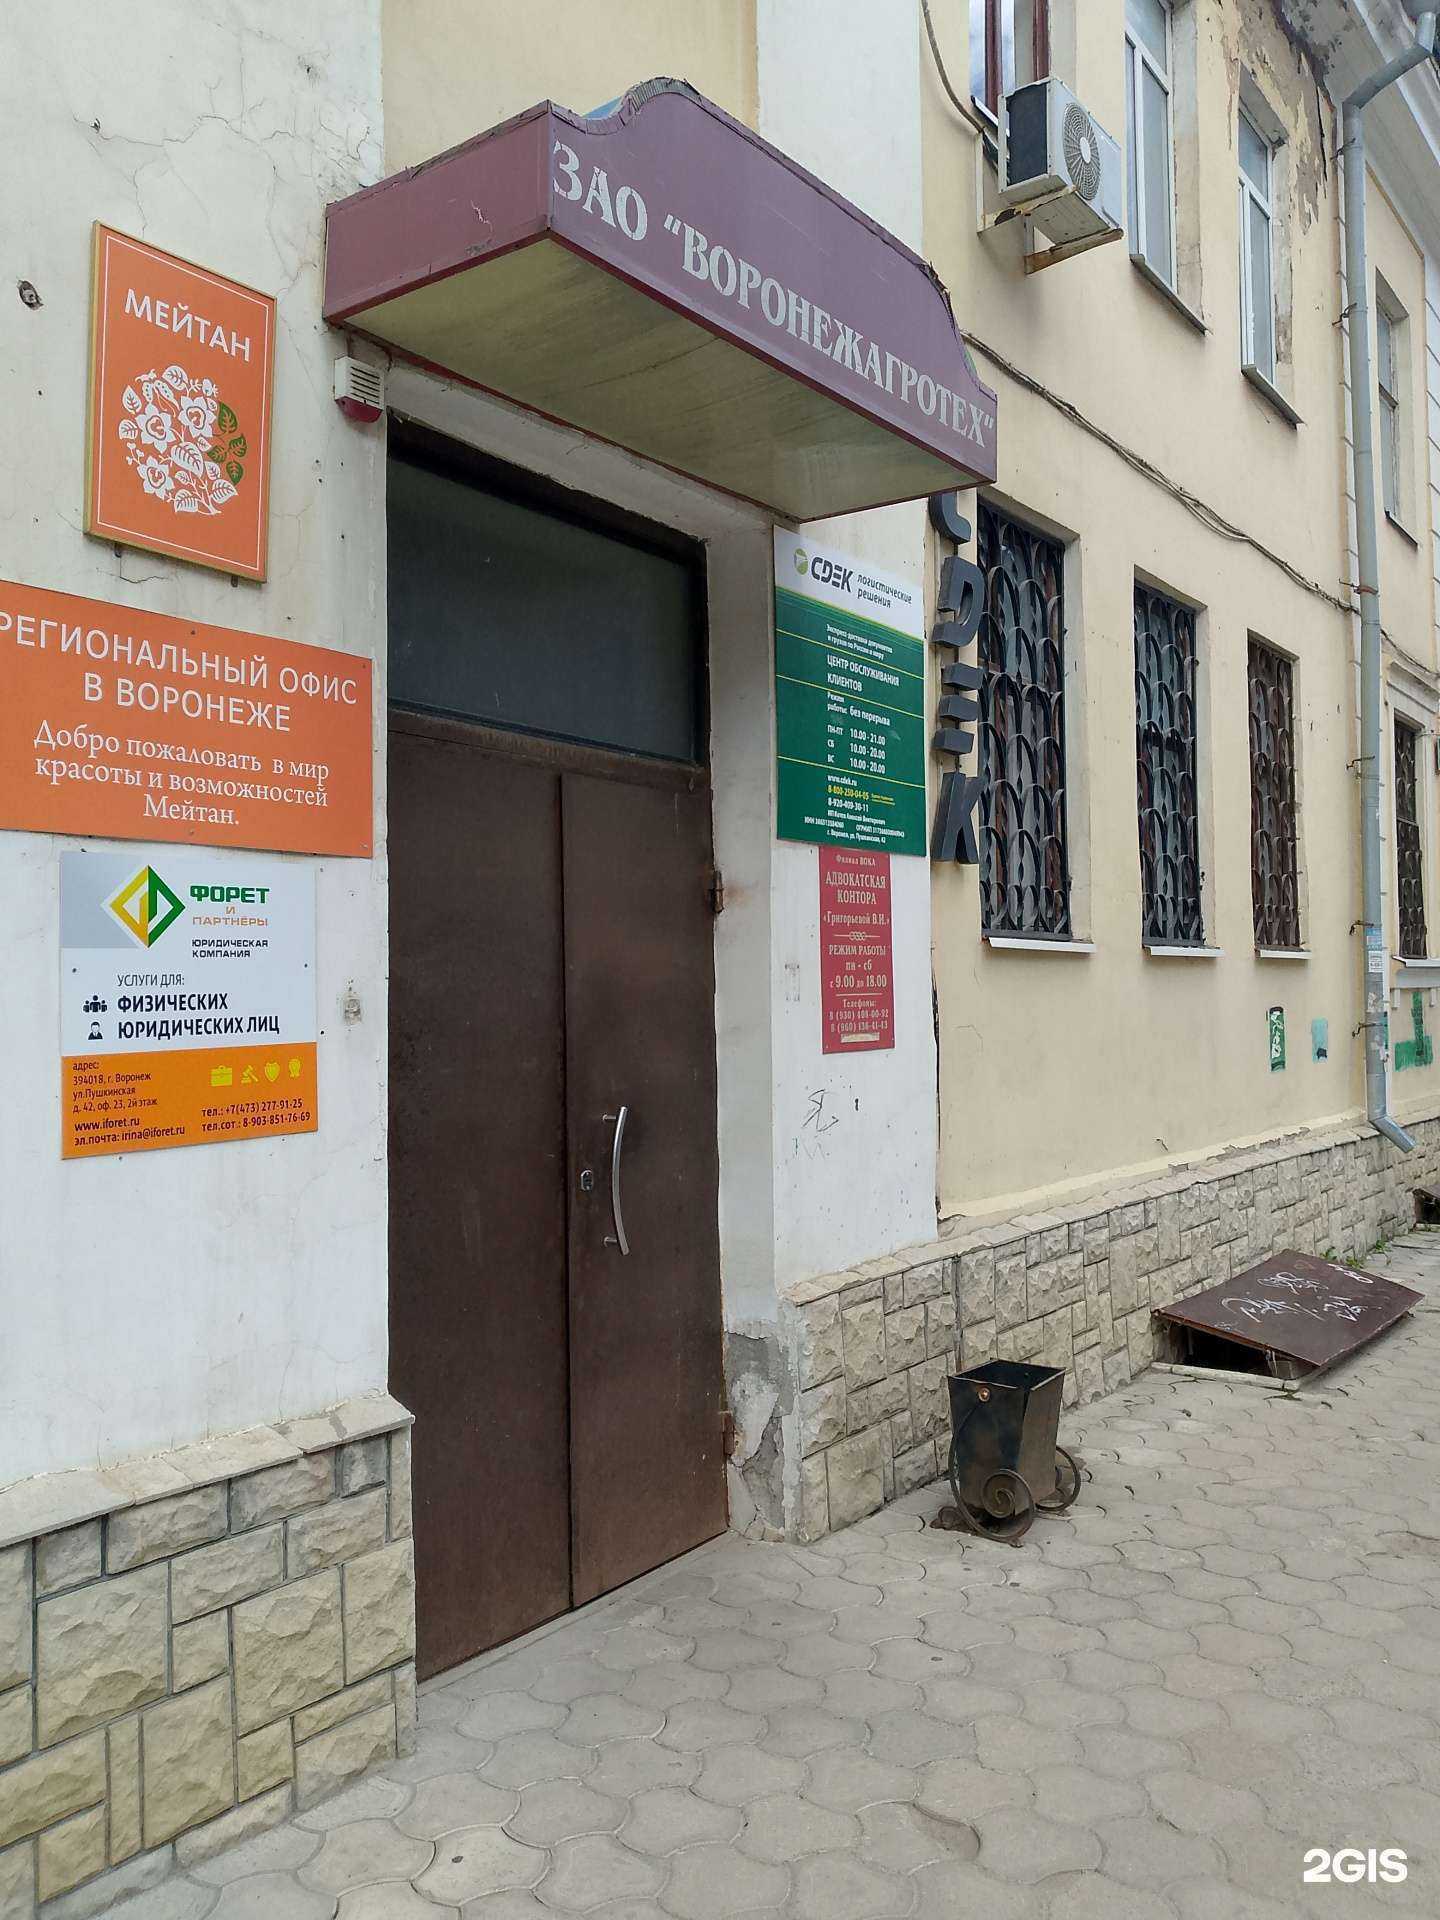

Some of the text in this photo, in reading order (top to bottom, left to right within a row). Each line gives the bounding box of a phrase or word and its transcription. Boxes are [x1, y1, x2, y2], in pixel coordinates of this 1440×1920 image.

[553, 140, 994, 449] ЗАО "ВОРОНЕЖАГРОТЕХ"
[124, 288, 251, 362] МЕЙТАН
[811, 556, 853, 593] CDEK
[857, 574, 912, 604] логистические
[857, 588, 891, 608] решения
[0, 611, 357, 704] РЕГИОНАЛЬНЫЙ ОФИС
[827, 655, 900, 687] ЦЕНТР ОБСЛУЖИВАНИЯ
[827, 673, 862, 692] КЛИЕНТОВ
[84, 672, 291, 732] В ВОРОНЕЖЕ
[850, 705, 861, 719] без
[861, 710, 890, 726] перерыва
[850, 728, 866, 740] 10.00
[870, 733, 885, 746] 21.00
[33, 719, 329, 787] Добро пожаловать в мир
[828, 739, 835, 748] СБ
[850, 743, 866, 754] 10.00
[870, 748, 885, 760] 20.00
[828, 755, 835, 763] ВС
[850, 758, 866, 769] 10.00
[870, 763, 885, 774] 20.00
[35, 757, 328, 808] красоты и возможностей
[143, 794, 240, 826] Мейтан.
[826, 871, 886, 888] АДВОКАТСКАЯ
[189, 885, 270, 904] ФОРЕТ
[837, 890, 877, 904] КОНТОРА
[225, 906, 236, 915] И
[191, 939, 269, 949] ЮРИДИЧЕСКАЯ
[829, 945, 886, 955] РЕЖИМ РАБОТЫ
[192, 949, 251, 959] КОМПАНИЯ
[863, 959, 872, 970] сб
[117, 973, 185, 988] УСЛУГИ ДЛЯ:
[835, 976, 854, 988] 9.00
[866, 975, 887, 987] 18.00
[117, 993, 228, 1013] ФИЗИЧЕСКИХ
[118, 1015, 280, 1041] ЮРИДИЧЕСКИХ ЛИЦ
[73, 1061, 99, 1072] адрес:
[115, 1072, 152, 1084] Воронеж
[138, 1098, 157, 1106] этаж
[261, 1098, 303, 1112] 277-91-25
[74, 1117, 140, 1132] www.iforet.ru
[122, 1126, 185, 1141] irina@iforet.ru
